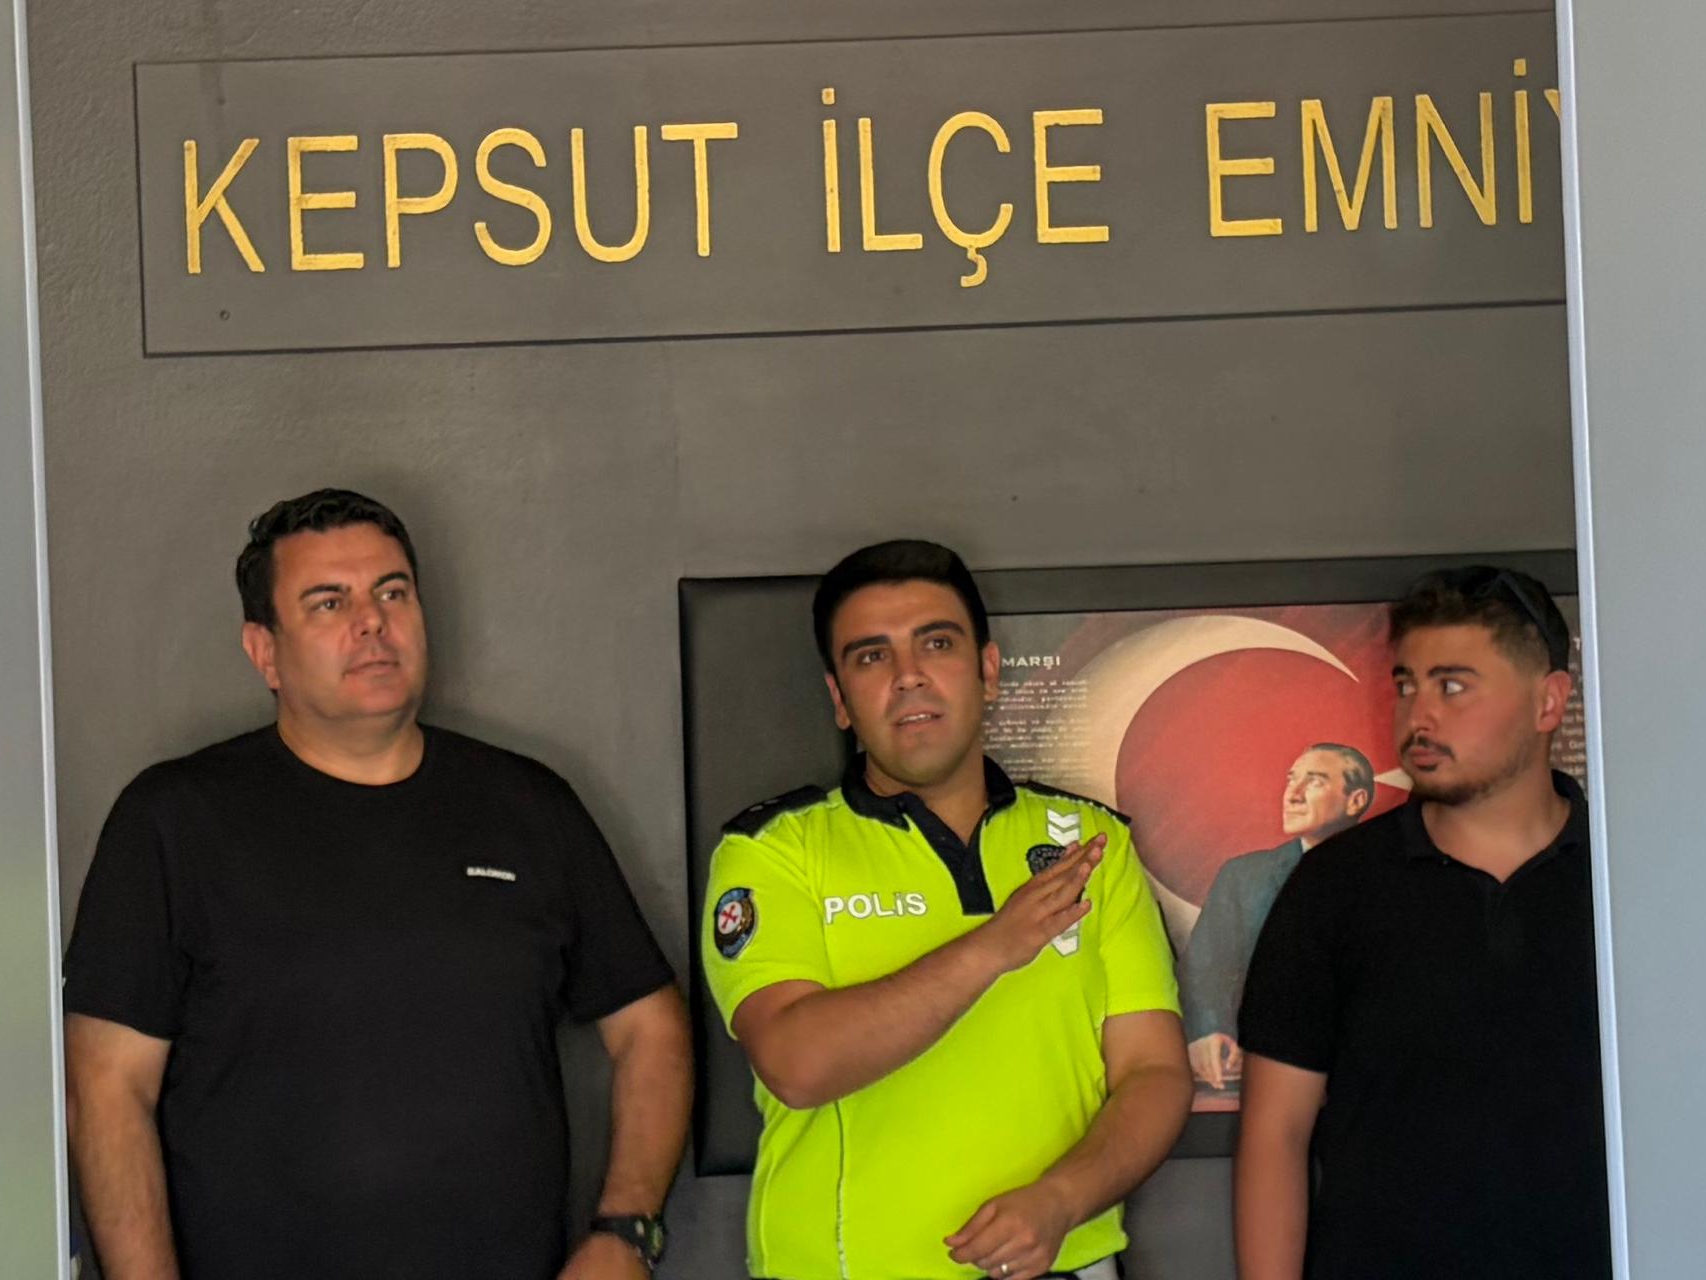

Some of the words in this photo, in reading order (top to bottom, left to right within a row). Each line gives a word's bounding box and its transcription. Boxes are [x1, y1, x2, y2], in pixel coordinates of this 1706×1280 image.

[183, 122, 739, 274] KEPSUT
[821, 86, 1110, 288] İLÇE
[1205, 58, 1560, 237] EMNİ
